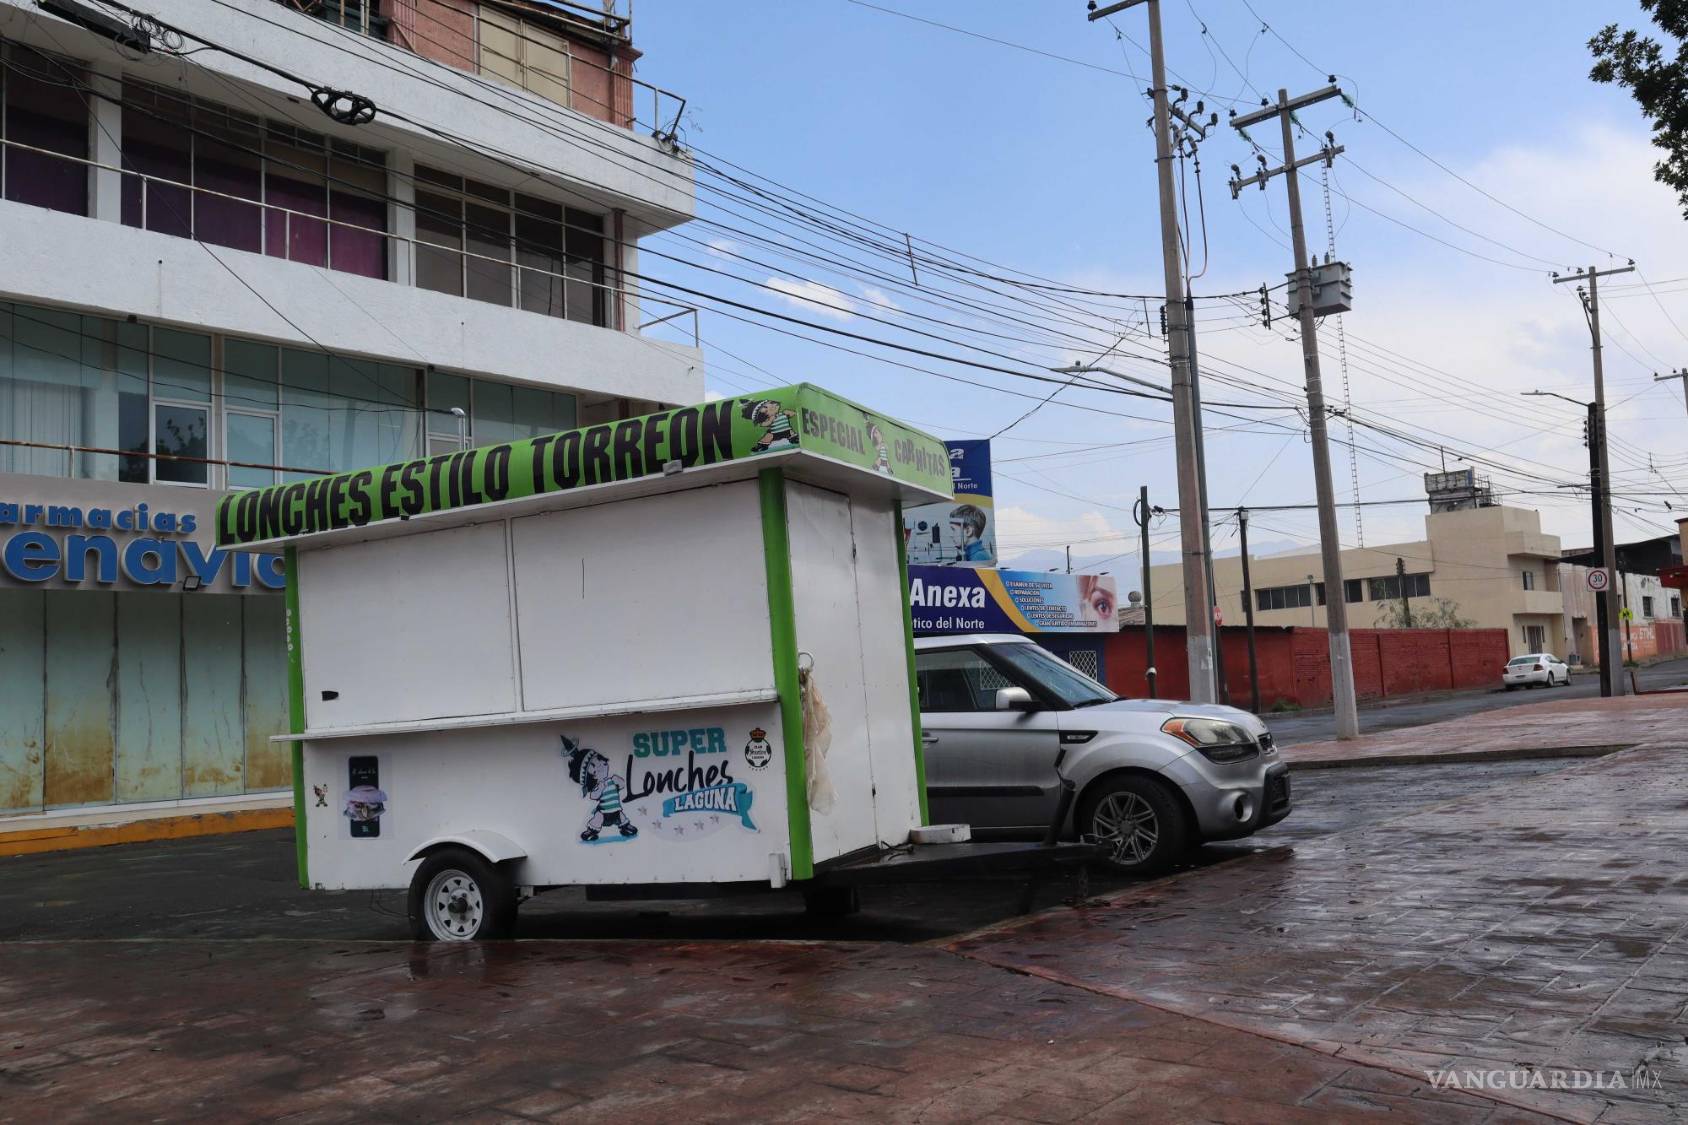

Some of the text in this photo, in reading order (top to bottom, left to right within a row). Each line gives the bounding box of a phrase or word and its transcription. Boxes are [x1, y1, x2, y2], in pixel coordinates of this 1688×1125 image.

[801, 407, 946, 477] ESPECIAL CARNITAS
[219, 399, 734, 545] LONCHES ESTILO TORREON
[0, 501, 198, 534] armacias
[909, 577, 986, 609] Anexa
[1593, 573, 1603, 583] 30
[912, 616, 985, 629] tico del Norte
[633, 727, 727, 758] SUPER
[622, 750, 734, 803] Lonches
[674, 786, 737, 811] LAGUNA
